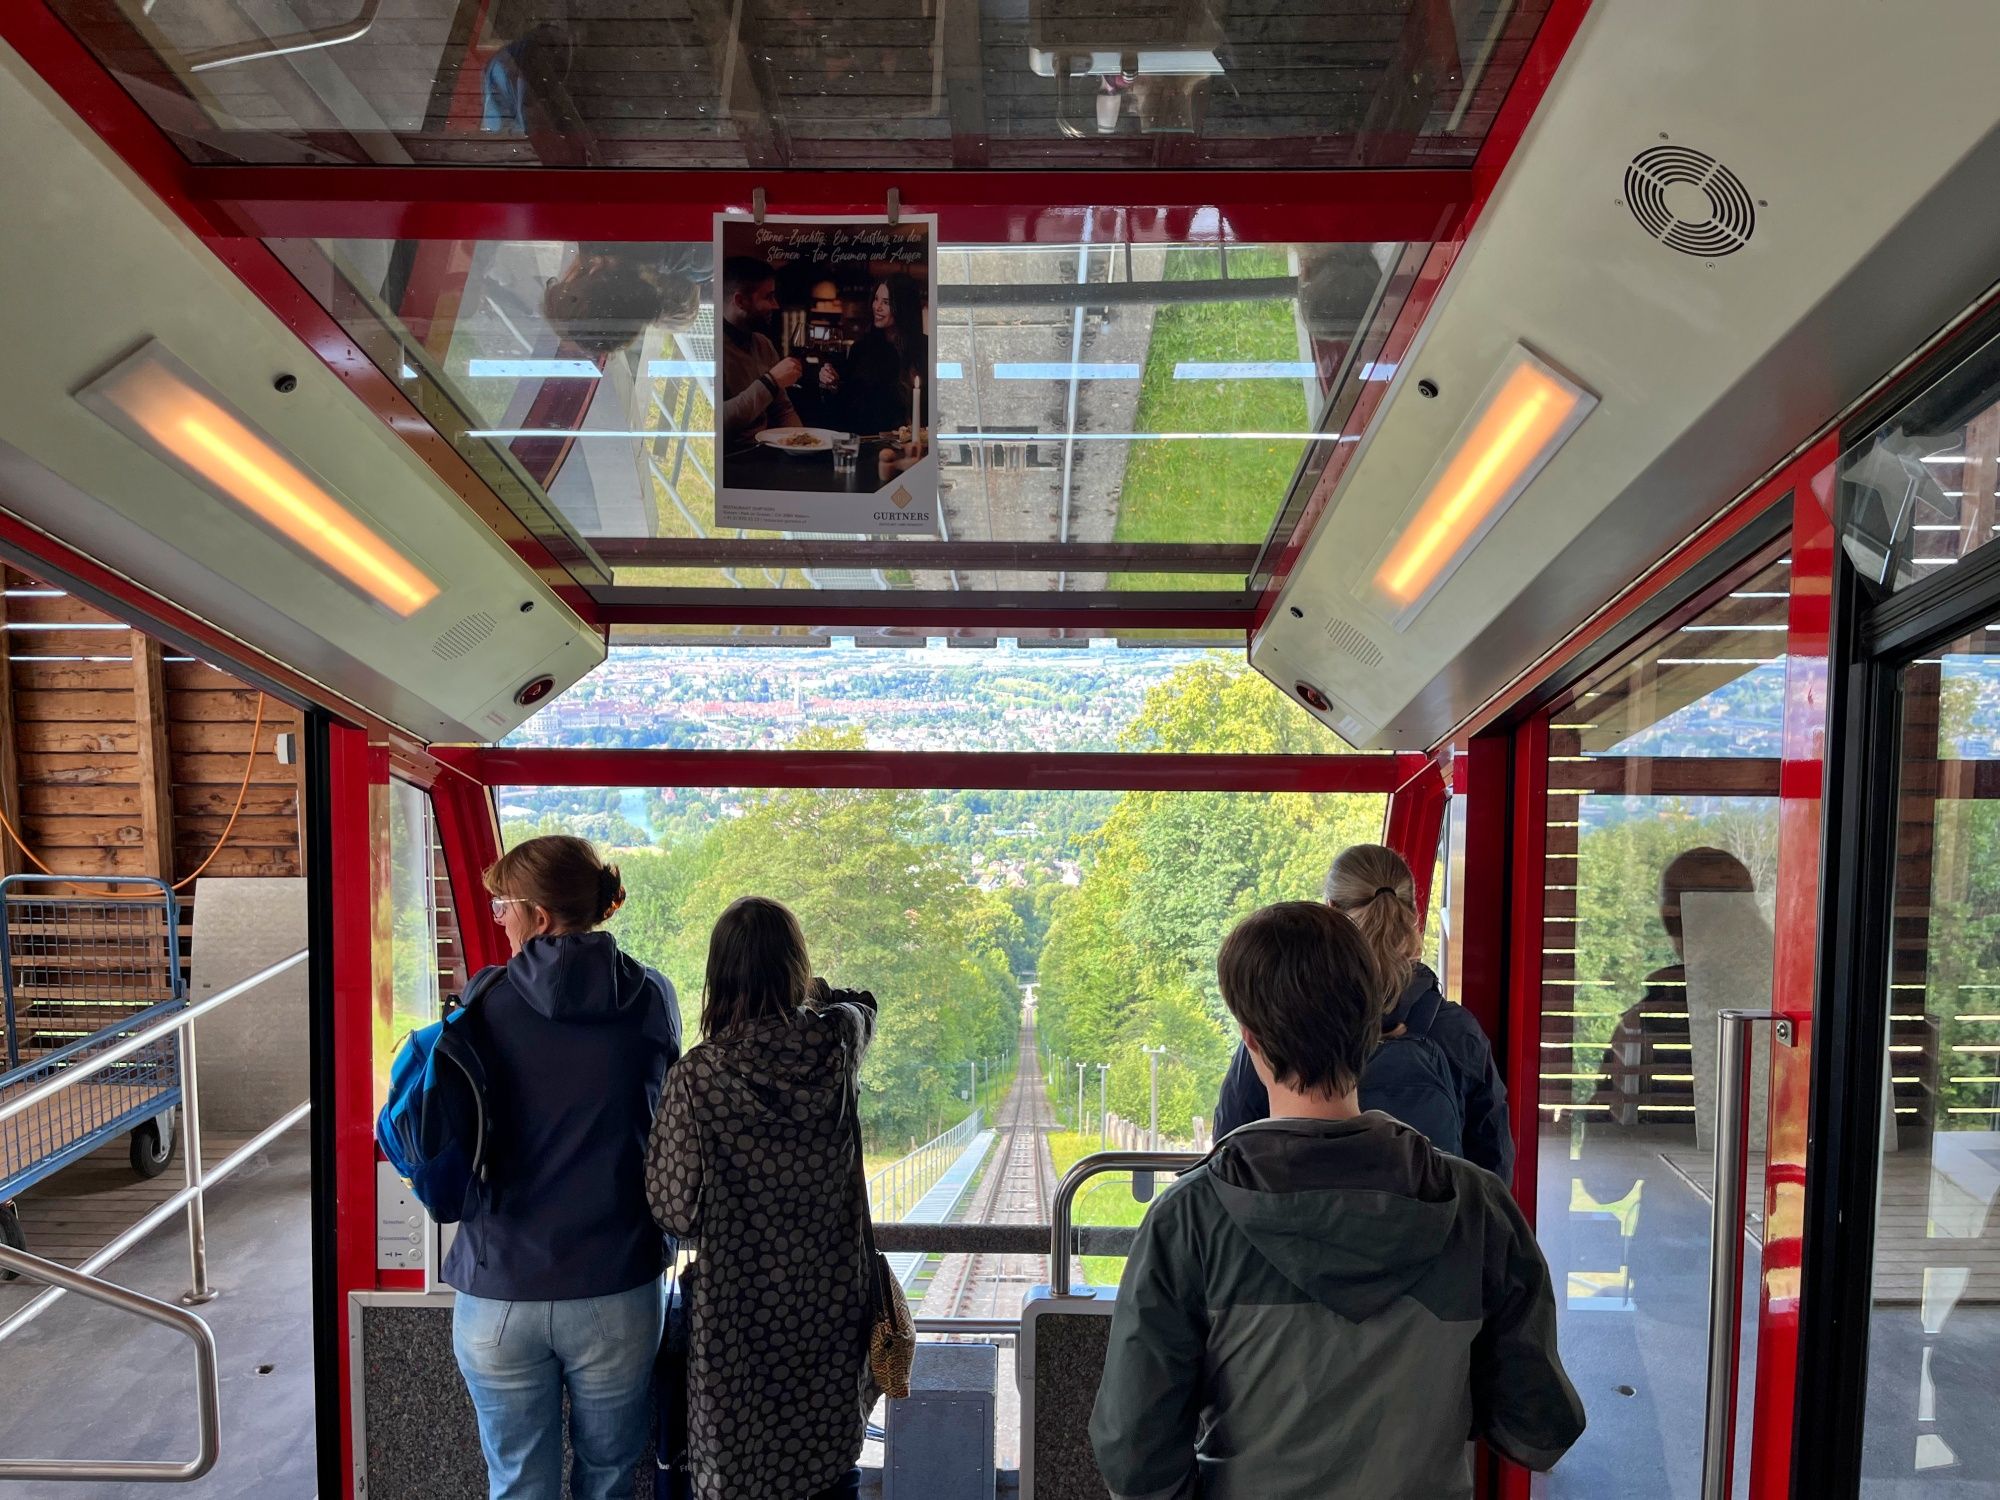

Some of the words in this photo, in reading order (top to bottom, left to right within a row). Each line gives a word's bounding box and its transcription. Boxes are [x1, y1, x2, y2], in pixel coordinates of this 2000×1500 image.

[832, 229, 849, 246] Ein
[851, 229, 890, 246] Ausflug
[892, 234, 904, 243] zu
[906, 228, 922, 243] den
[830, 246, 867, 263] Gaumen
[870, 246, 888, 260] und
[889, 246, 922, 264] Augen
[873, 512, 929, 521] GURTNERS
